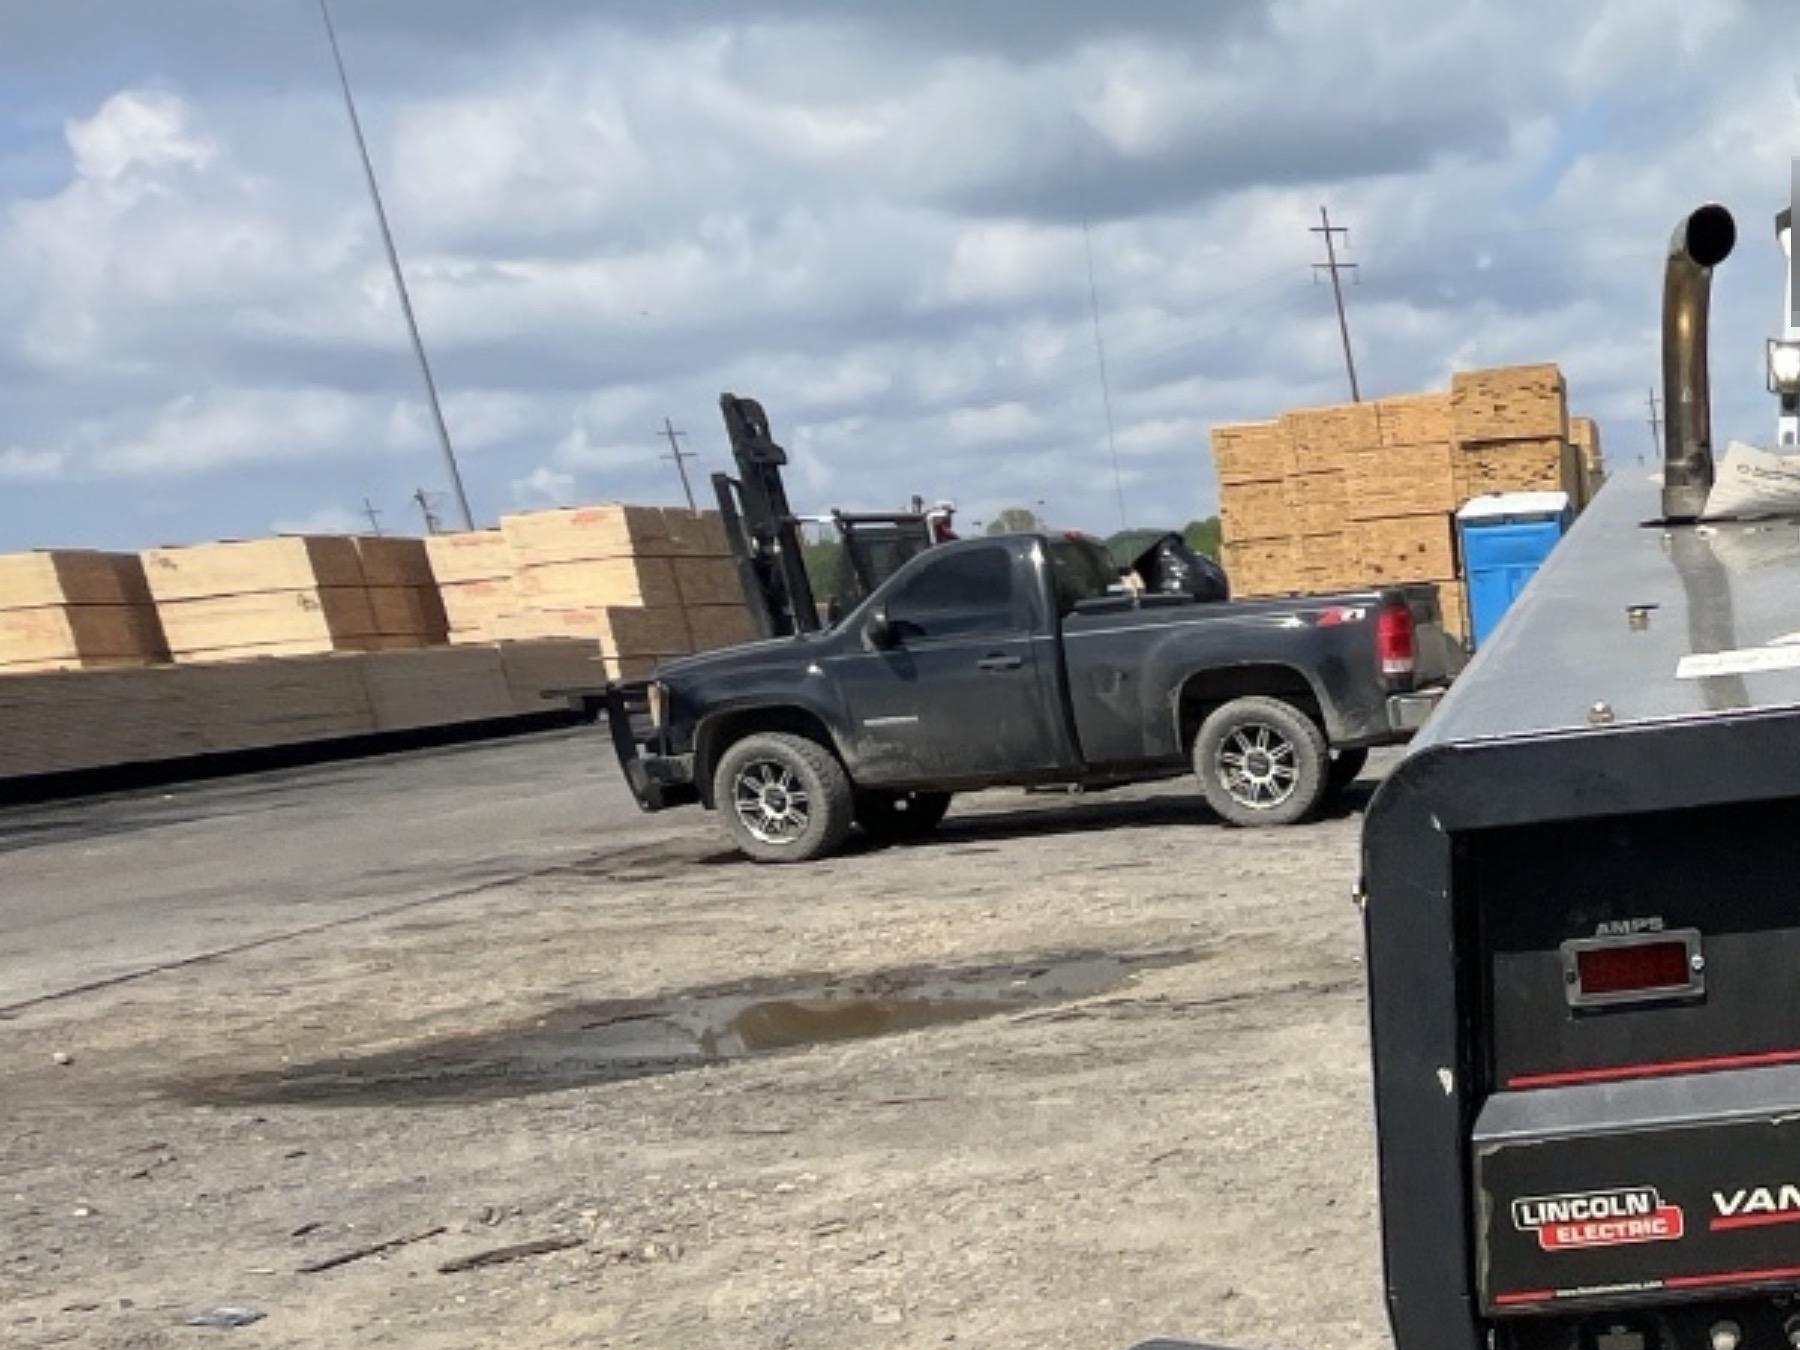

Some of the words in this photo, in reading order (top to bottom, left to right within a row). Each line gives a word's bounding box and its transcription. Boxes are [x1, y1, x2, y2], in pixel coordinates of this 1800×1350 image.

[1596, 916, 1664, 936] AMPS
[1523, 1194, 1651, 1225] LINCOLN
[1556, 1218, 1669, 1243] ELECTRIC
